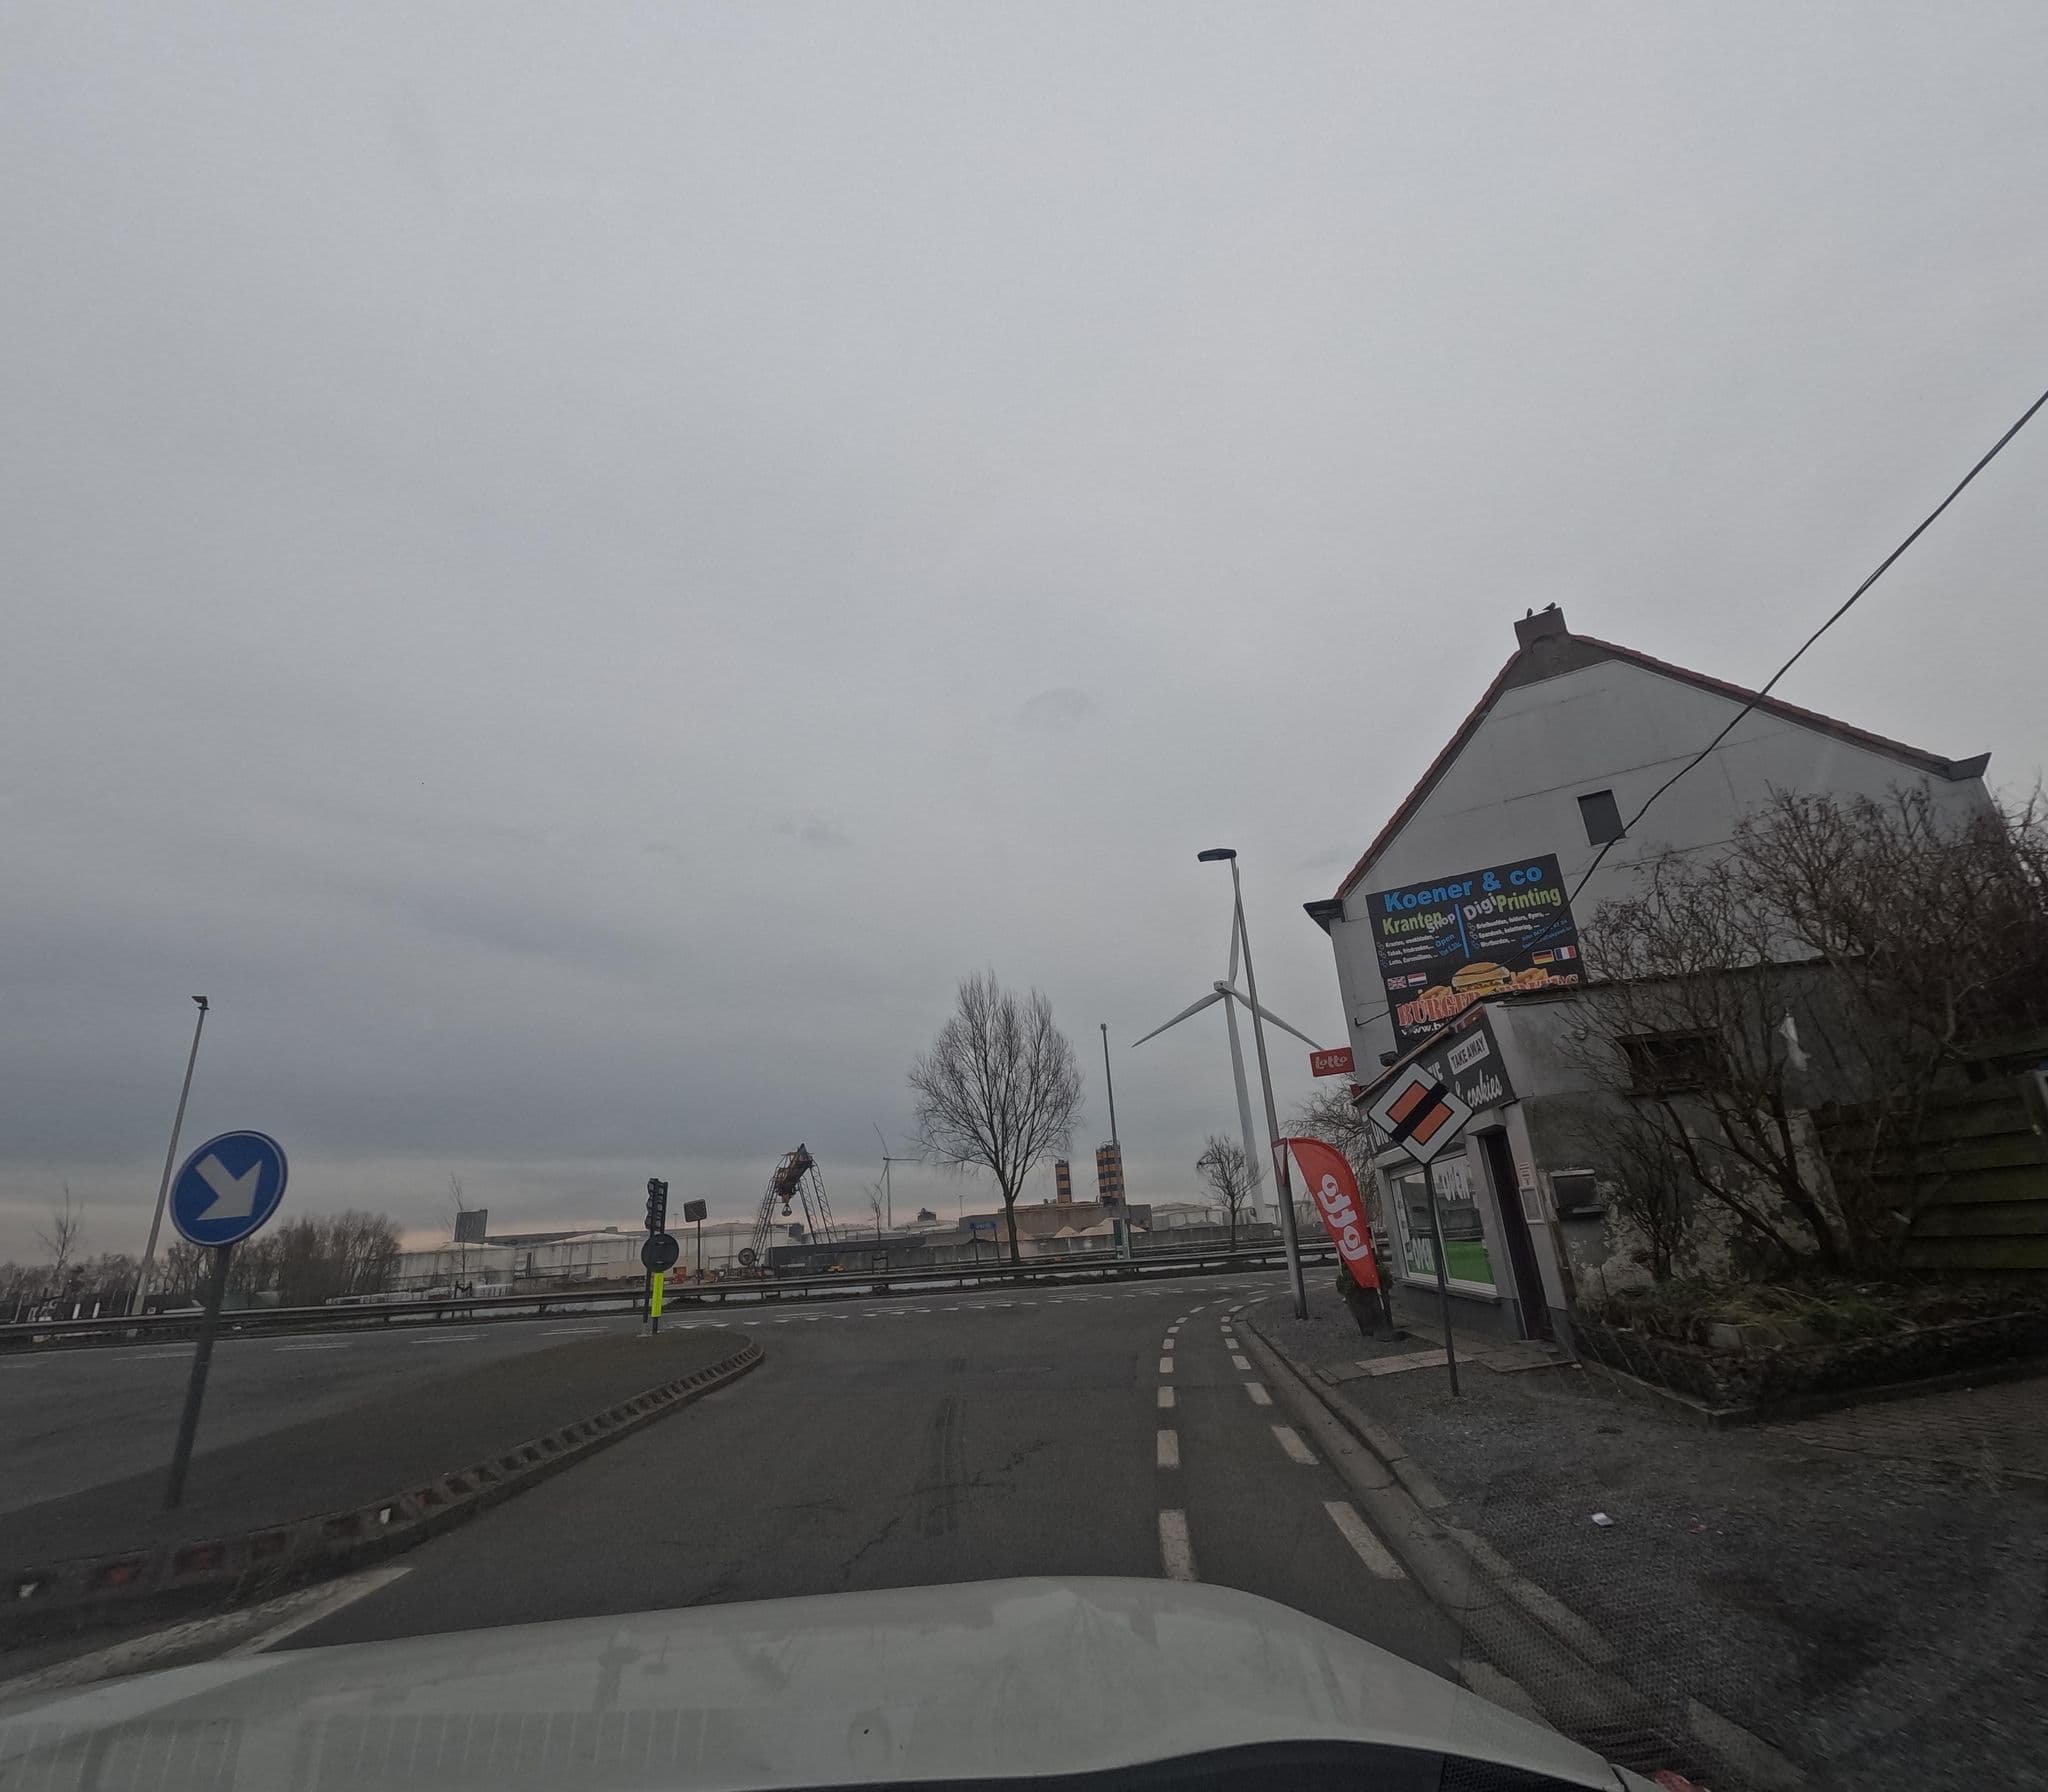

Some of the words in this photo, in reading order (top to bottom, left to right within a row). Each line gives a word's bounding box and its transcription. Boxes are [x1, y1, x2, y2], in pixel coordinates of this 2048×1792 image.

[1384, 881, 1473, 912] Koener
[1482, 871, 1502, 892] &
[1508, 866, 1543, 886] co
[1451, 1049, 1468, 1067] TAKE
[1467, 1038, 1486, 1060] AWAY
[1467, 1069, 1503, 1107] cookies
